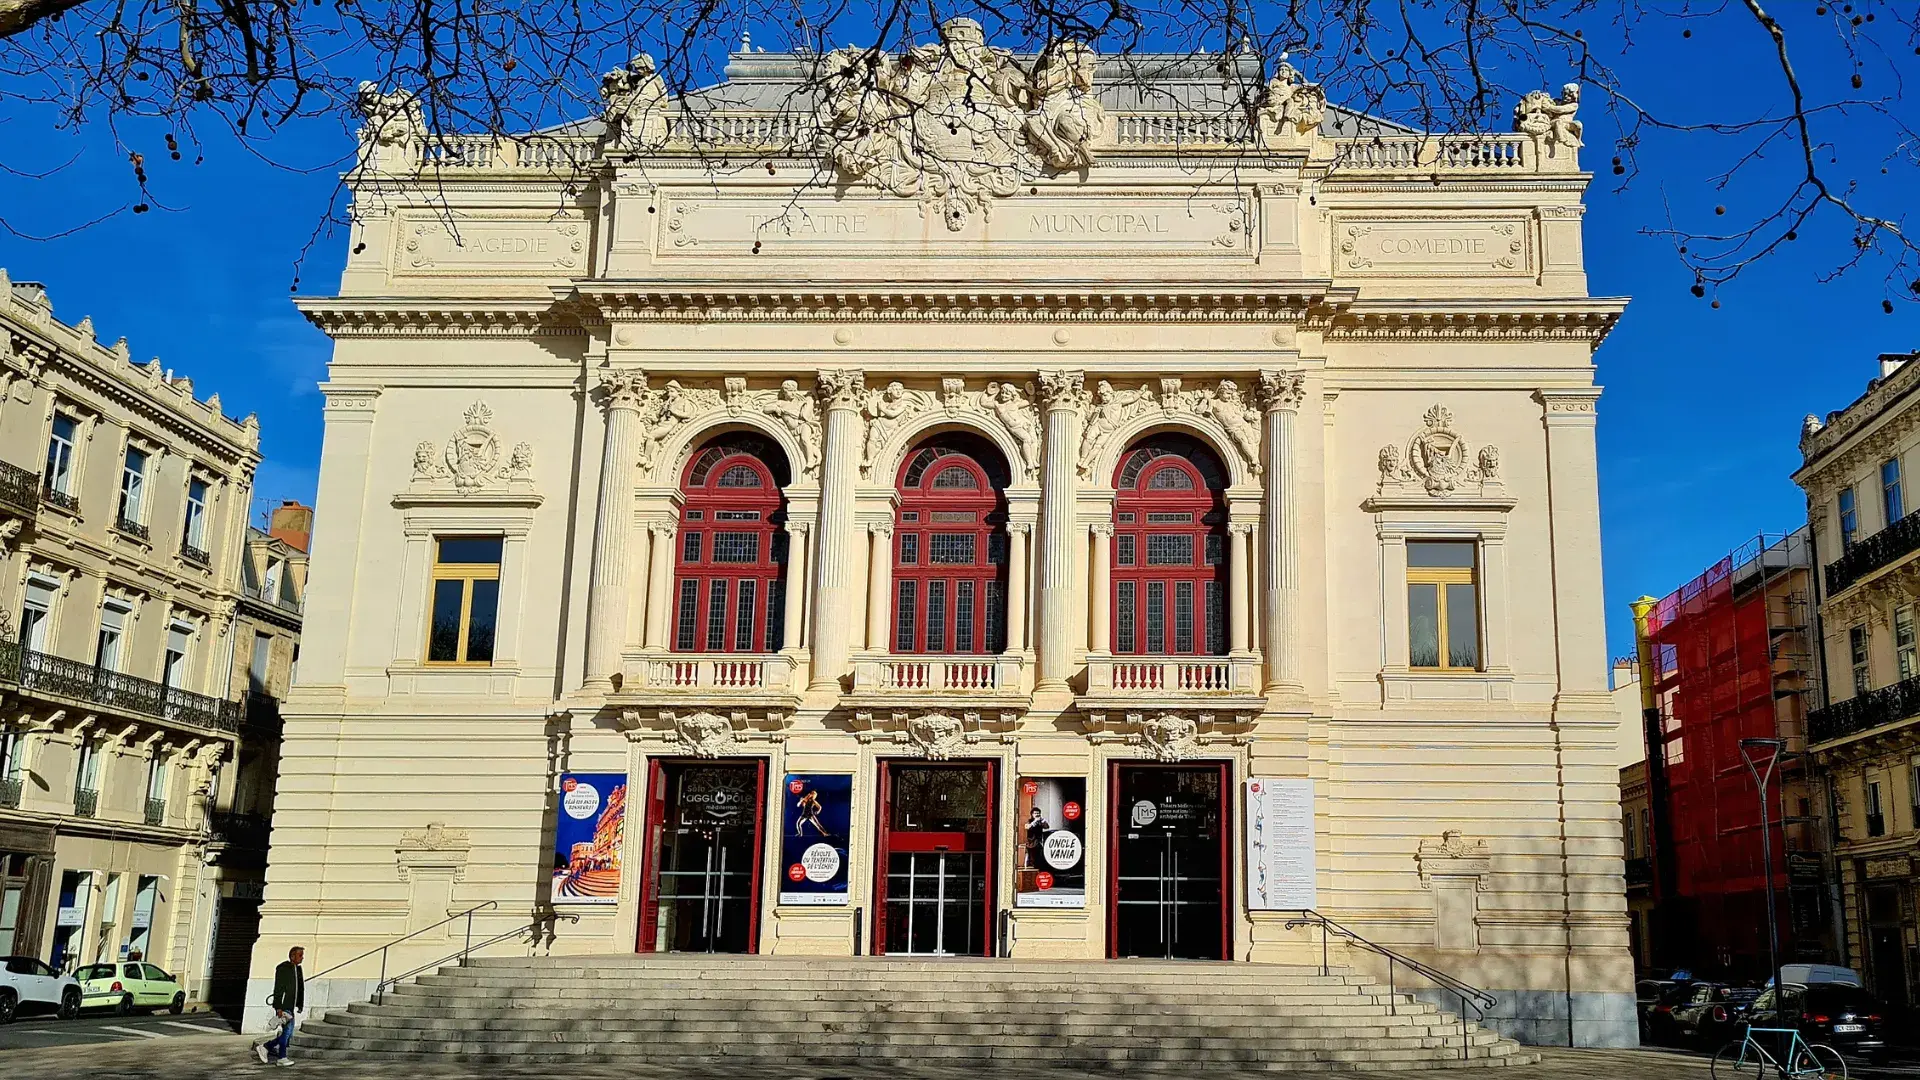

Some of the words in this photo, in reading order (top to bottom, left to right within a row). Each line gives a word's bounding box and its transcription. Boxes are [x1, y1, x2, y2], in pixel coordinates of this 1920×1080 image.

[746, 214, 868, 234] THEATRE
[1029, 214, 1169, 233] MUNICIPAL
[443, 237, 549, 253] TRAGEDIE
[1380, 238, 1487, 254] COMEDIE
[1049, 838, 1077, 848] ONCLE
[1050, 849, 1075, 859] VANIA
